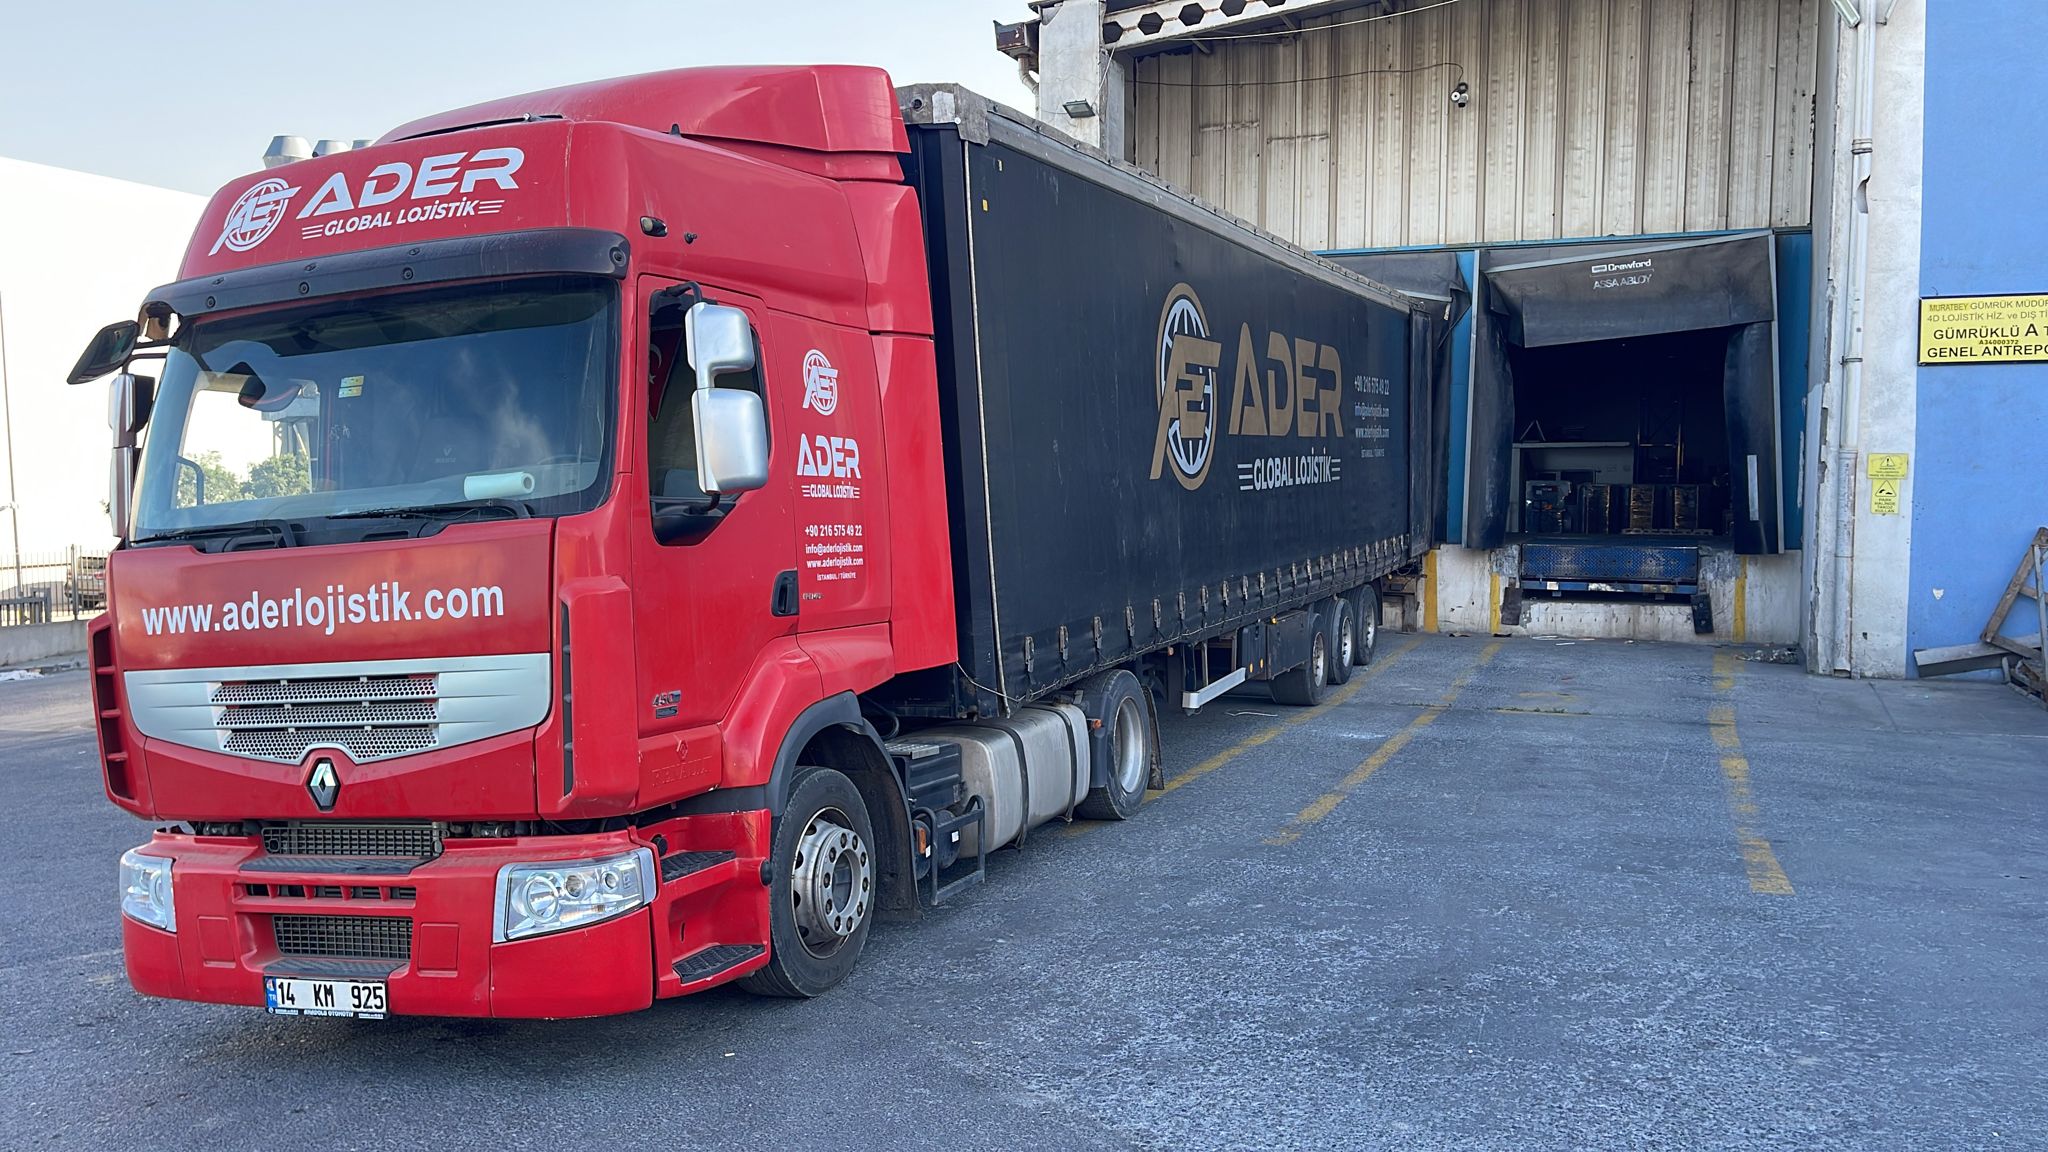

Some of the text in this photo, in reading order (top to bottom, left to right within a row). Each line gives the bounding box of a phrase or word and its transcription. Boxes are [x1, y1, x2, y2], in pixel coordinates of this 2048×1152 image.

[296, 147, 525, 219] ADER
[324, 197, 480, 236] GLOBAL LOJİSTİK
[1593, 274, 1652, 290] ASSA ABLOY
[1929, 303, 1968, 312] MURATBEY
[1970, 300, 2013, 310] GÜMRÜK
[1928, 314, 1940, 322] 4D
[1942, 312, 1984, 322] LOJİSTİK
[2020, 310, 2036, 320] DIŞ
[1933, 324, 2020, 340] GÜMRÜKLÜ
[2025, 323, 2039, 337] A
[1927, 347, 1978, 358] GENEL
[1228, 322, 1344, 437] ADER
[796, 433, 861, 479] ADER
[1253, 446, 1331, 491] GLOBAL LOJİSTİK
[810, 484, 833, 498] GLOBAL
[804, 524, 863, 537] +90 216 575 49 22
[805, 543, 864, 556] info@aderlojistik.com
[806, 556, 864, 569] www.aderlojistik.com
[141, 582, 505, 636] www.aderlojistik.com
[278, 982, 384, 1010] 14 KM 925
